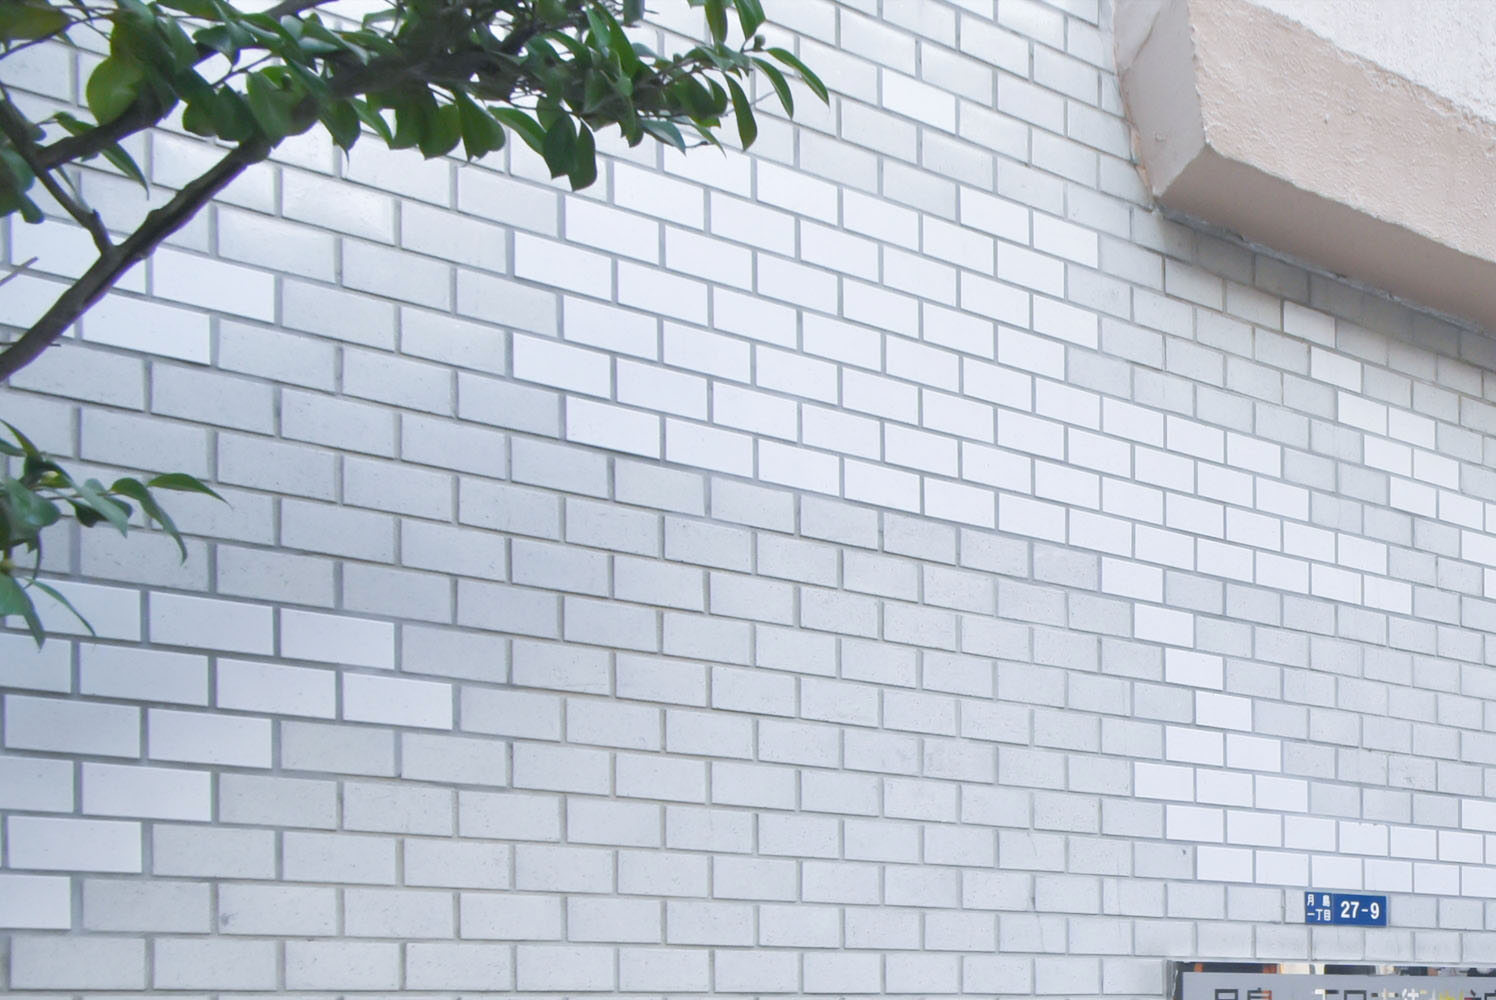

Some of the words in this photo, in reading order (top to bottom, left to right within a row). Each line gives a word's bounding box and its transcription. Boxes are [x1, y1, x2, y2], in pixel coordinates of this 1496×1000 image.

[1306, 893, 1331, 907] 月島
[1306, 908, 1332, 921] 一丁目
[1340, 900, 1380, 920] 27-9
